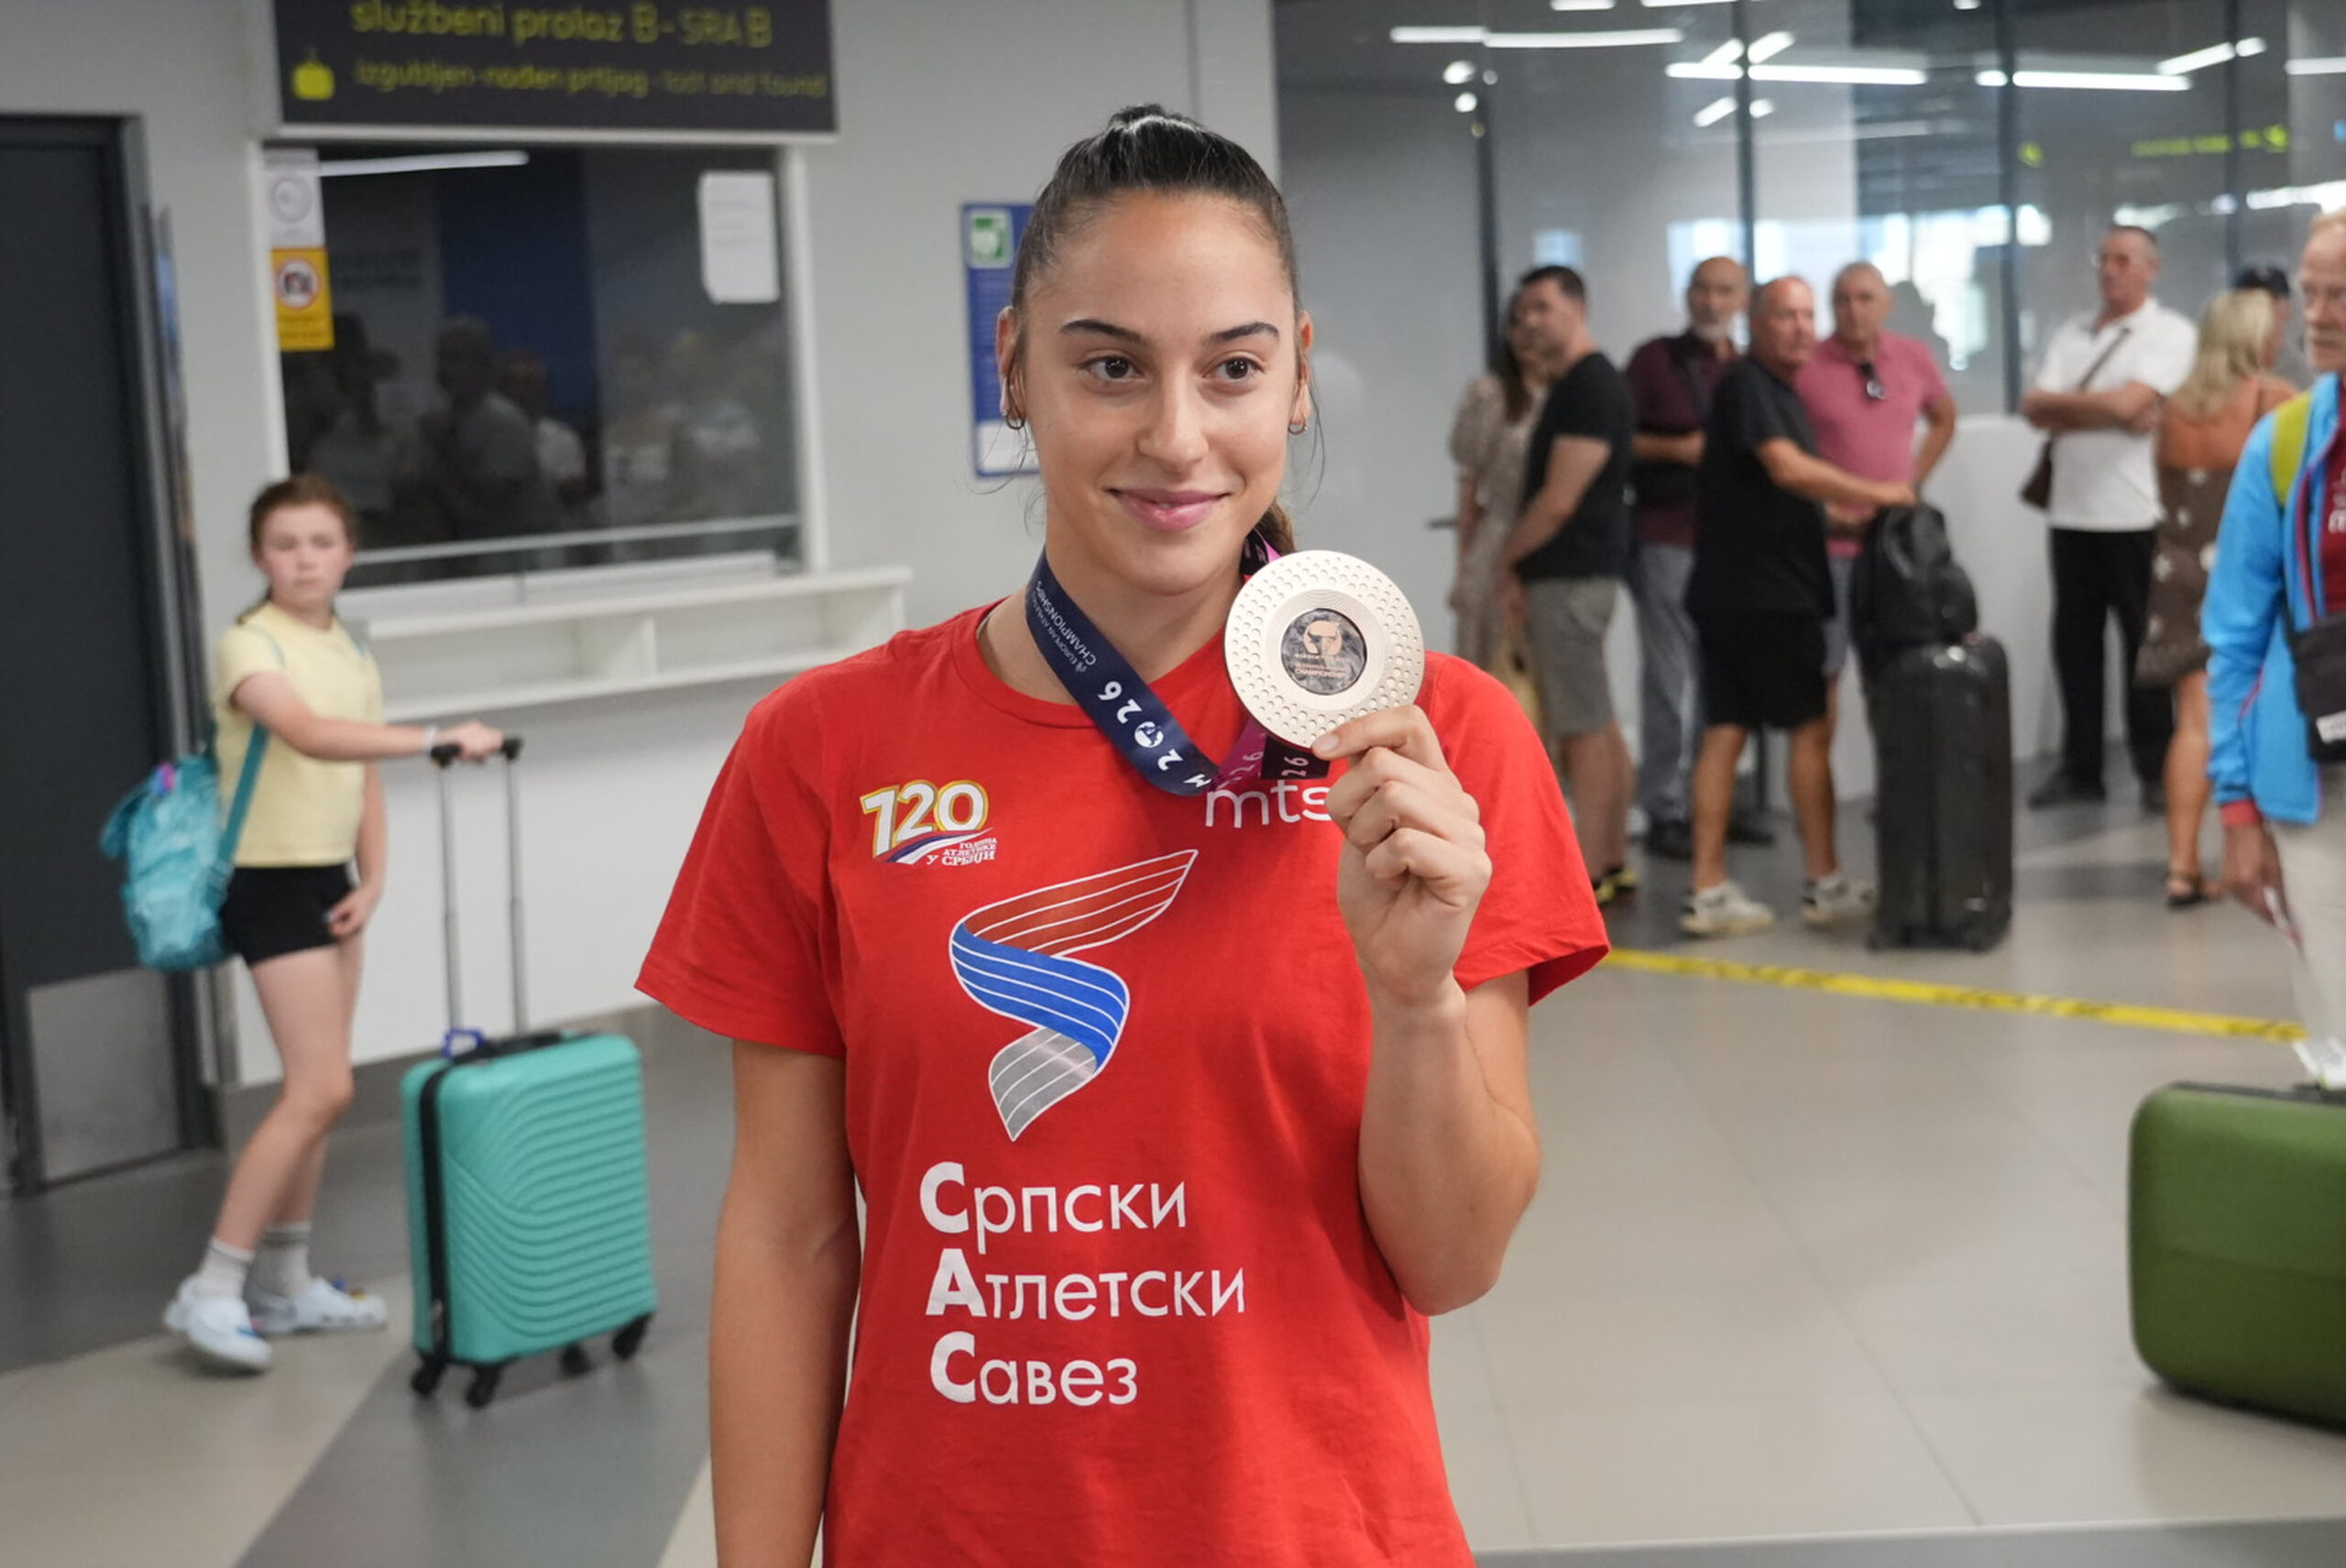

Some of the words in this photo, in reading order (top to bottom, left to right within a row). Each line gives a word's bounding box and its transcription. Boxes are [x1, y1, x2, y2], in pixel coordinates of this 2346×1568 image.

[513, 7, 625, 45] prolaz
[860, 779, 989, 859] 120
[1205, 779, 1332, 828] mts
[920, 1161, 1187, 1255] Српски
[926, 1247, 1245, 1321] Атлетски
[930, 1331, 1139, 1407] Савез
